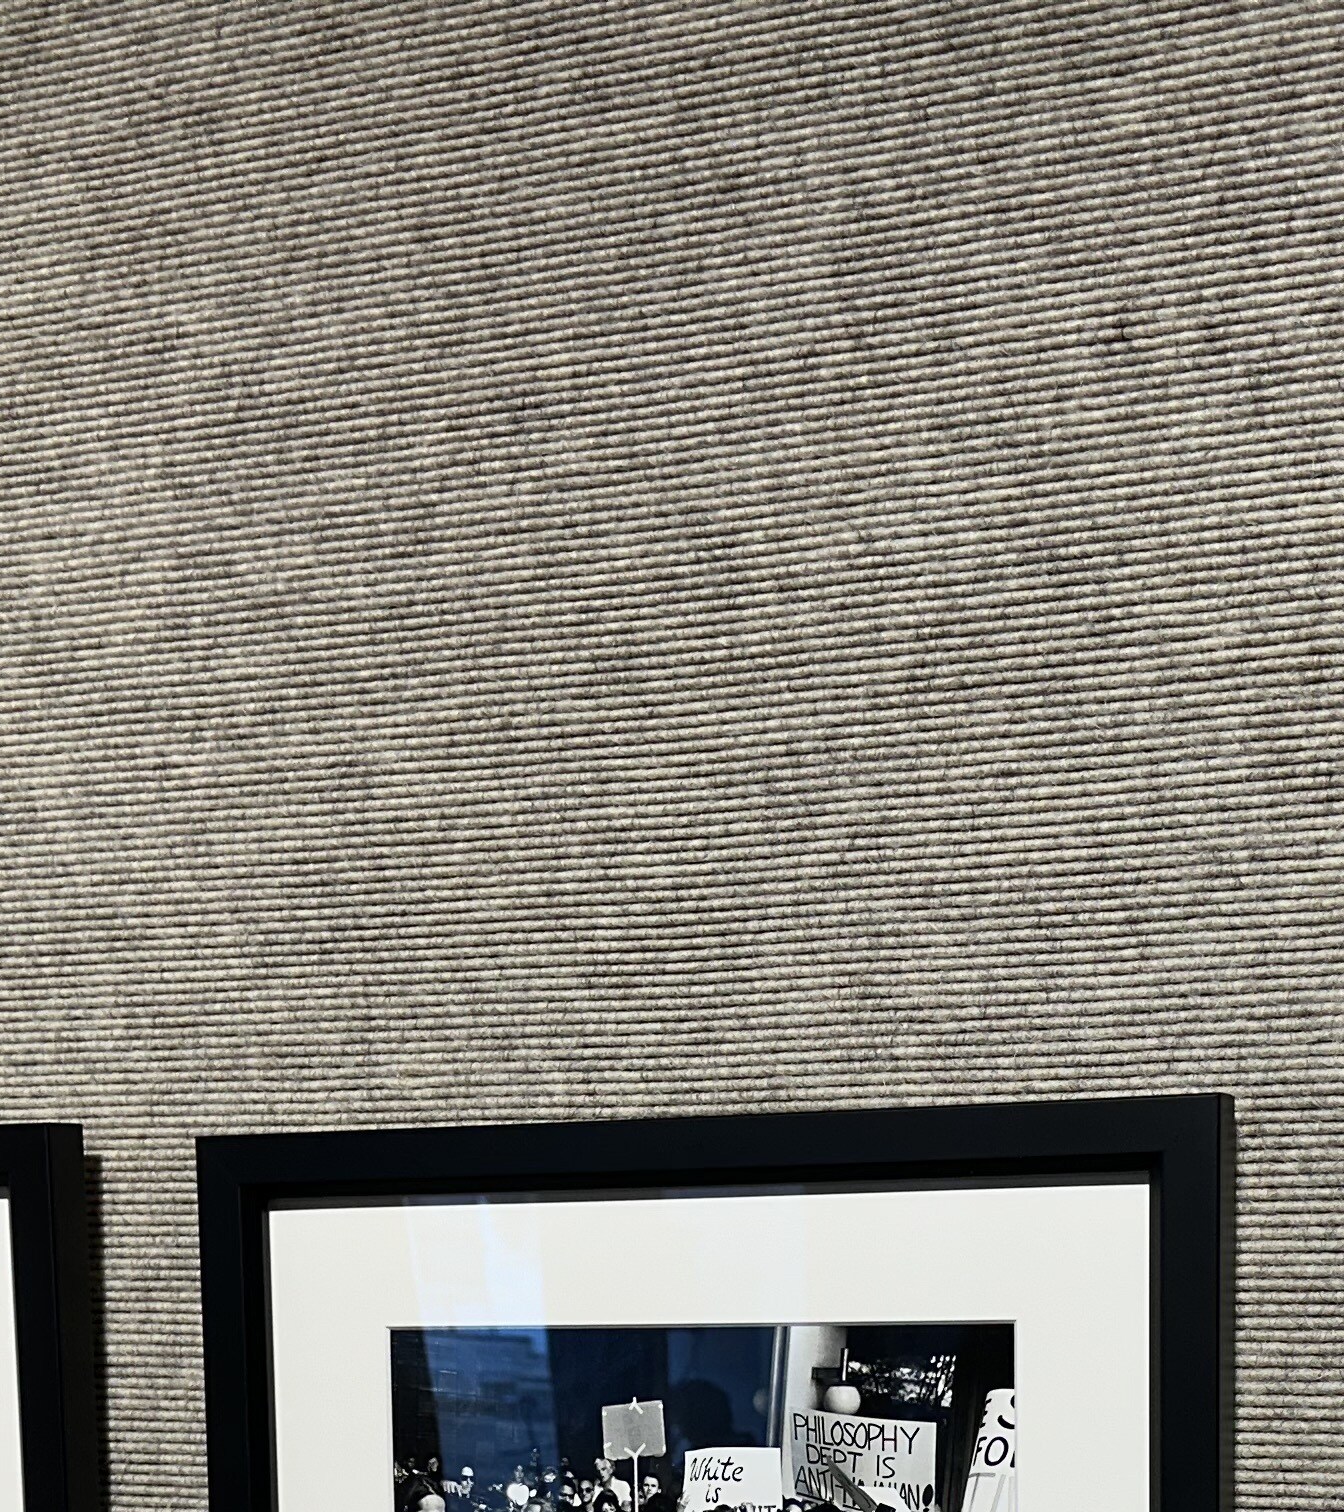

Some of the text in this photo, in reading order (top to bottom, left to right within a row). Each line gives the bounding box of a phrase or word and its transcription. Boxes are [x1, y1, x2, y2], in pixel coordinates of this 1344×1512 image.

[793, 1413, 921, 1455] PHILOSOPHY
[806, 1443, 896, 1479] DEPT IS
[972, 1436, 1015, 1468] FO
[689, 1456, 744, 1482] White
[705, 1483, 722, 1503] is
